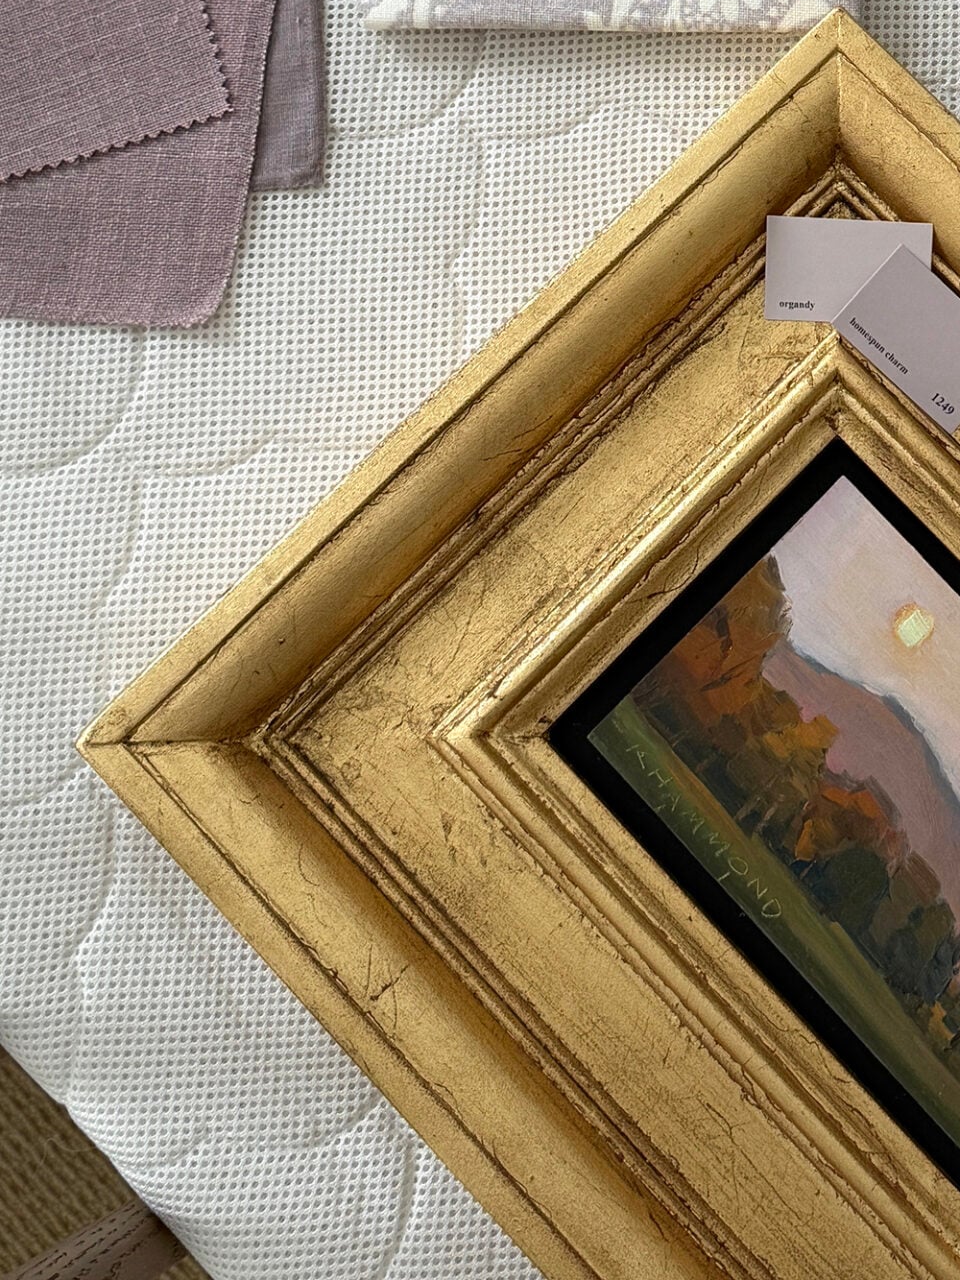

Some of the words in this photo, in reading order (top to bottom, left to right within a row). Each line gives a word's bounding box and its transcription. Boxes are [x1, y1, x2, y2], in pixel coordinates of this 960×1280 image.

[779, 300, 815, 310] organdy
[849, 317, 885, 354] homespun
[885, 351, 908, 375] charm
[931, 393, 955, 415] 1249
